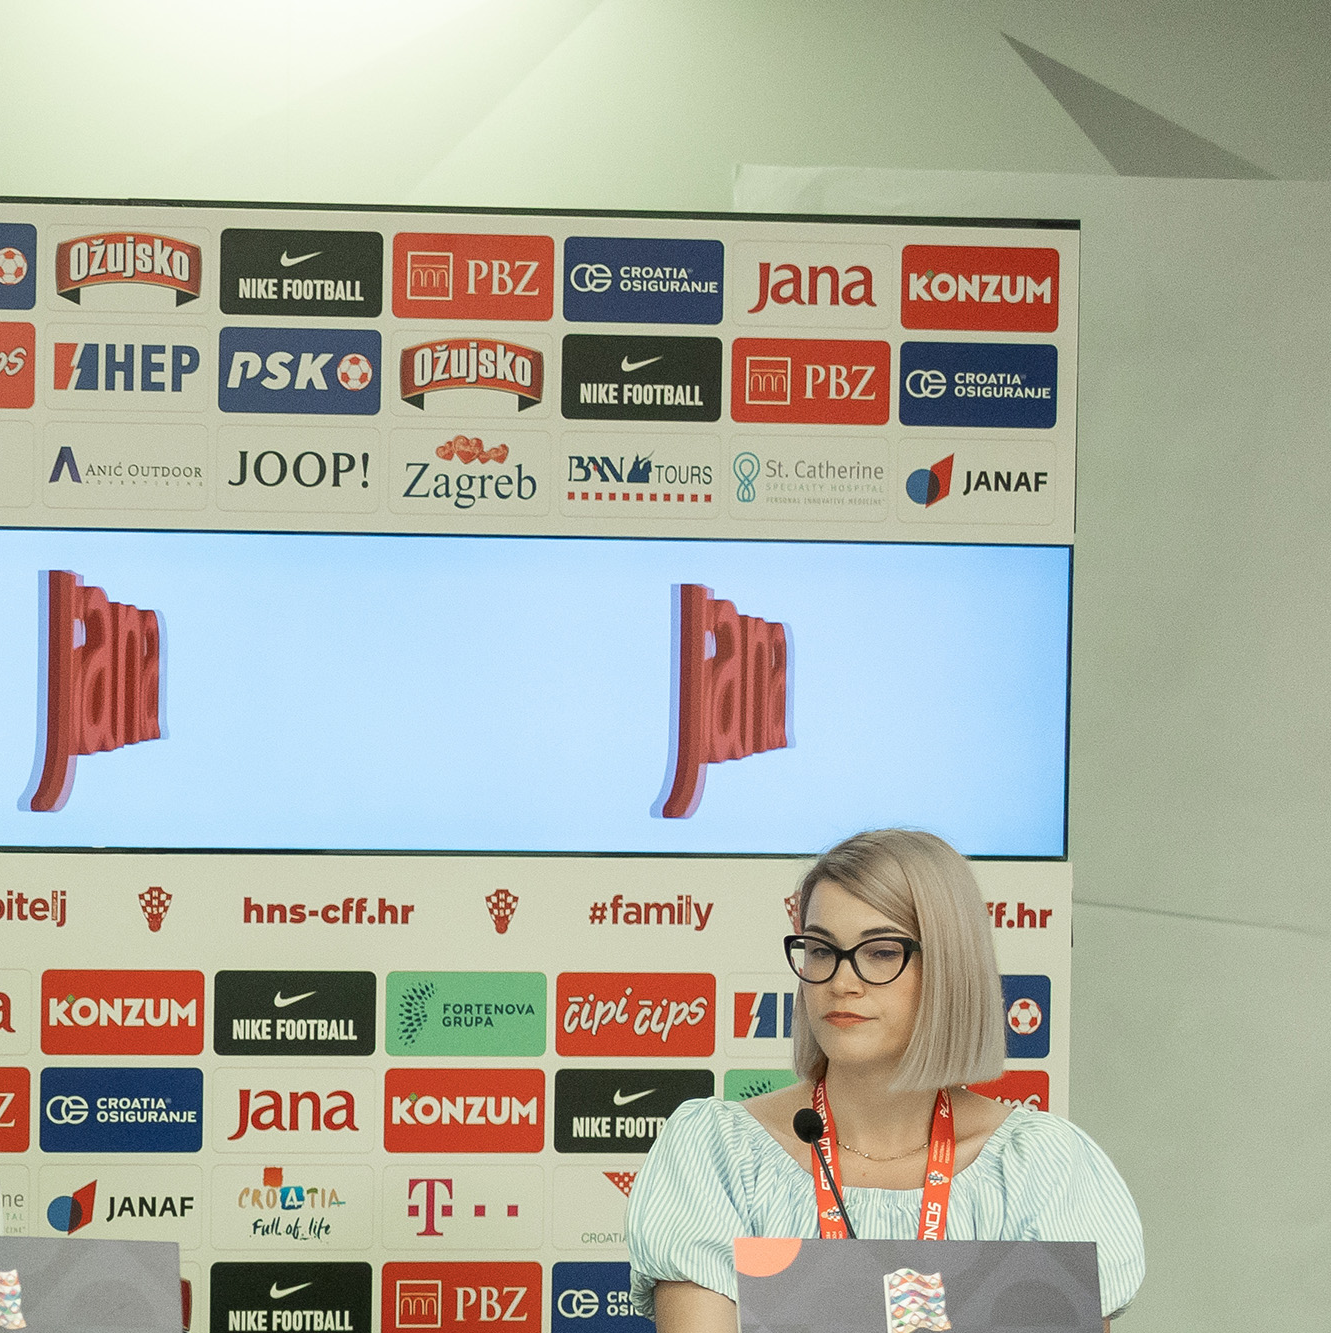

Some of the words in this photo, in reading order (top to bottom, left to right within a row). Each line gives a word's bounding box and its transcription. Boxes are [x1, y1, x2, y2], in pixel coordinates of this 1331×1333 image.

[70, 236, 190, 281] Ožujsko
[467, 260, 539, 295] PBZ
[620, 266, 688, 279] CROATIA
[239, 278, 278, 299] NIKE
[283, 279, 364, 301] FOOTBALL
[620, 279, 718, 293] OSIGURANJE
[909, 271, 1051, 303] KONZUM
[105, 344, 200, 392] HEP
[227, 352, 333, 390] PSK
[413, 346, 531, 388] Ožujsko
[955, 372, 1021, 385] CROATIA
[580, 383, 618, 404] NIKE
[623, 384, 703, 406] FOOTBALL
[805, 365, 875, 400] PBZ
[954, 386, 1051, 399] OSIGURANJE
[228, 451, 369, 488] JOOP!
[655, 465, 712, 485] TOURS
[766, 460, 788, 478] St.
[795, 460, 884, 480] Catherine
[403, 463, 536, 509] Zagreb
[963, 471, 1047, 495] JANAF
[244, 897, 414, 924] hns-cff.hr
[589, 895, 713, 931] #family
[49, 995, 196, 1026] KONZUM
[442, 1016, 493, 1027] GRUPA
[443, 1004, 534, 1015] FORTENOVA
[232, 1019, 272, 1040] NIKE
[276, 1019, 357, 1040] FOOTBALL
[97, 1098, 166, 1109] CROATIA
[392, 1093, 537, 1124] KONZUM
[97, 1111, 197, 1123] OSIGURANJE
[106, 1197, 194, 1222] JANAF
[456, 1287, 527, 1321] PBZ
[228, 1310, 268, 1331] NIKE
[272, 1310, 353, 1331] FOOTBALL
